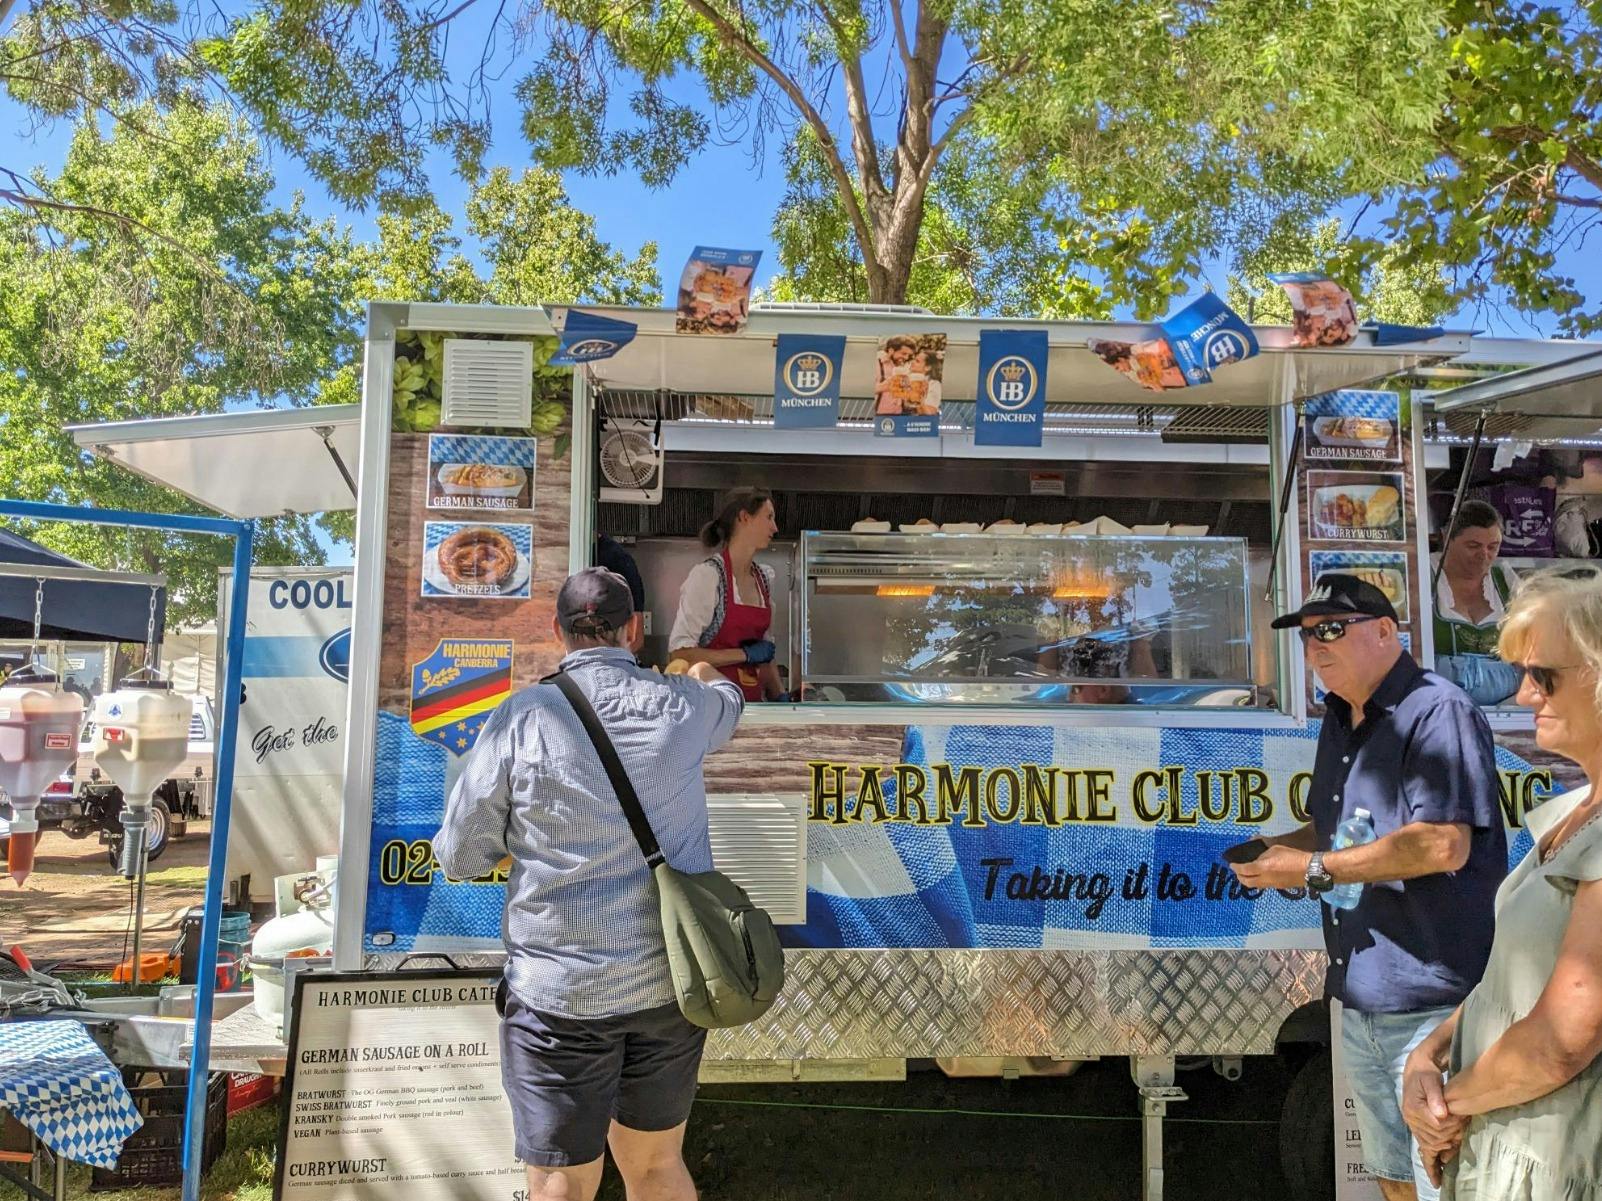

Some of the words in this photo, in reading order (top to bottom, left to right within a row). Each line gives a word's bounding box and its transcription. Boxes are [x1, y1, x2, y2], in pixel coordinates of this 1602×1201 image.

[1190, 311, 1229, 342] MÜNCHE
[797, 371, 820, 388] HB
[999, 381, 1024, 401] HB
[781, 397, 832, 408] MÜNCHEN
[983, 412, 1036, 423] MÜNCHEN
[1310, 447, 1348, 458] GERMAN
[1350, 448, 1387, 459] SAUSAGE
[433, 496, 474, 508] GERMAN
[476, 497, 519, 509] SAUSAGE
[1327, 528, 1389, 539] CURRYWURST
[269, 579, 352, 610] COOL
[455, 583, 501, 595] PRETZELS
[443, 643, 511, 658] HARMONIE
[454, 658, 499, 668] CANBERRA
[252, 725, 295, 764] Get
[303, 716, 338, 747] the
[807, 760, 1118, 828] HARMONIE
[1132, 765, 1274, 828] CLUB
[980, 857, 1114, 920] Taking
[1122, 862, 1149, 900] it
[1157, 862, 1198, 901] to
[318, 989, 407, 1007] HARMONIE
[412, 988, 453, 1003] CLUB
[458, 987, 497, 1001] CATE
[301, 1047, 359, 1064] GERMAN
[362, 1045, 421, 1061] SAUSAGE
[424, 1044, 441, 1059] ON
[445, 1044, 454, 1057] A
[459, 1042, 489, 1056] ROLL
[297, 1090, 346, 1100] BRATWURST
[295, 1103, 322, 1112] SWISS
[323, 1100, 372, 1111] BRATWURST
[418, 1097, 431, 1105] pork
[294, 1114, 335, 1125] KRANSKY
[358, 1113, 381, 1121] smoked
[294, 1129, 320, 1138] VEGAN
[360, 1127, 383, 1135] sausage
[289, 1158, 387, 1177] CURRYWURST
[288, 1180, 312, 1188] German
[314, 1179, 337, 1187] sausage
[450, 1171, 466, 1179] curry
[497, 1167, 509, 1175] half
